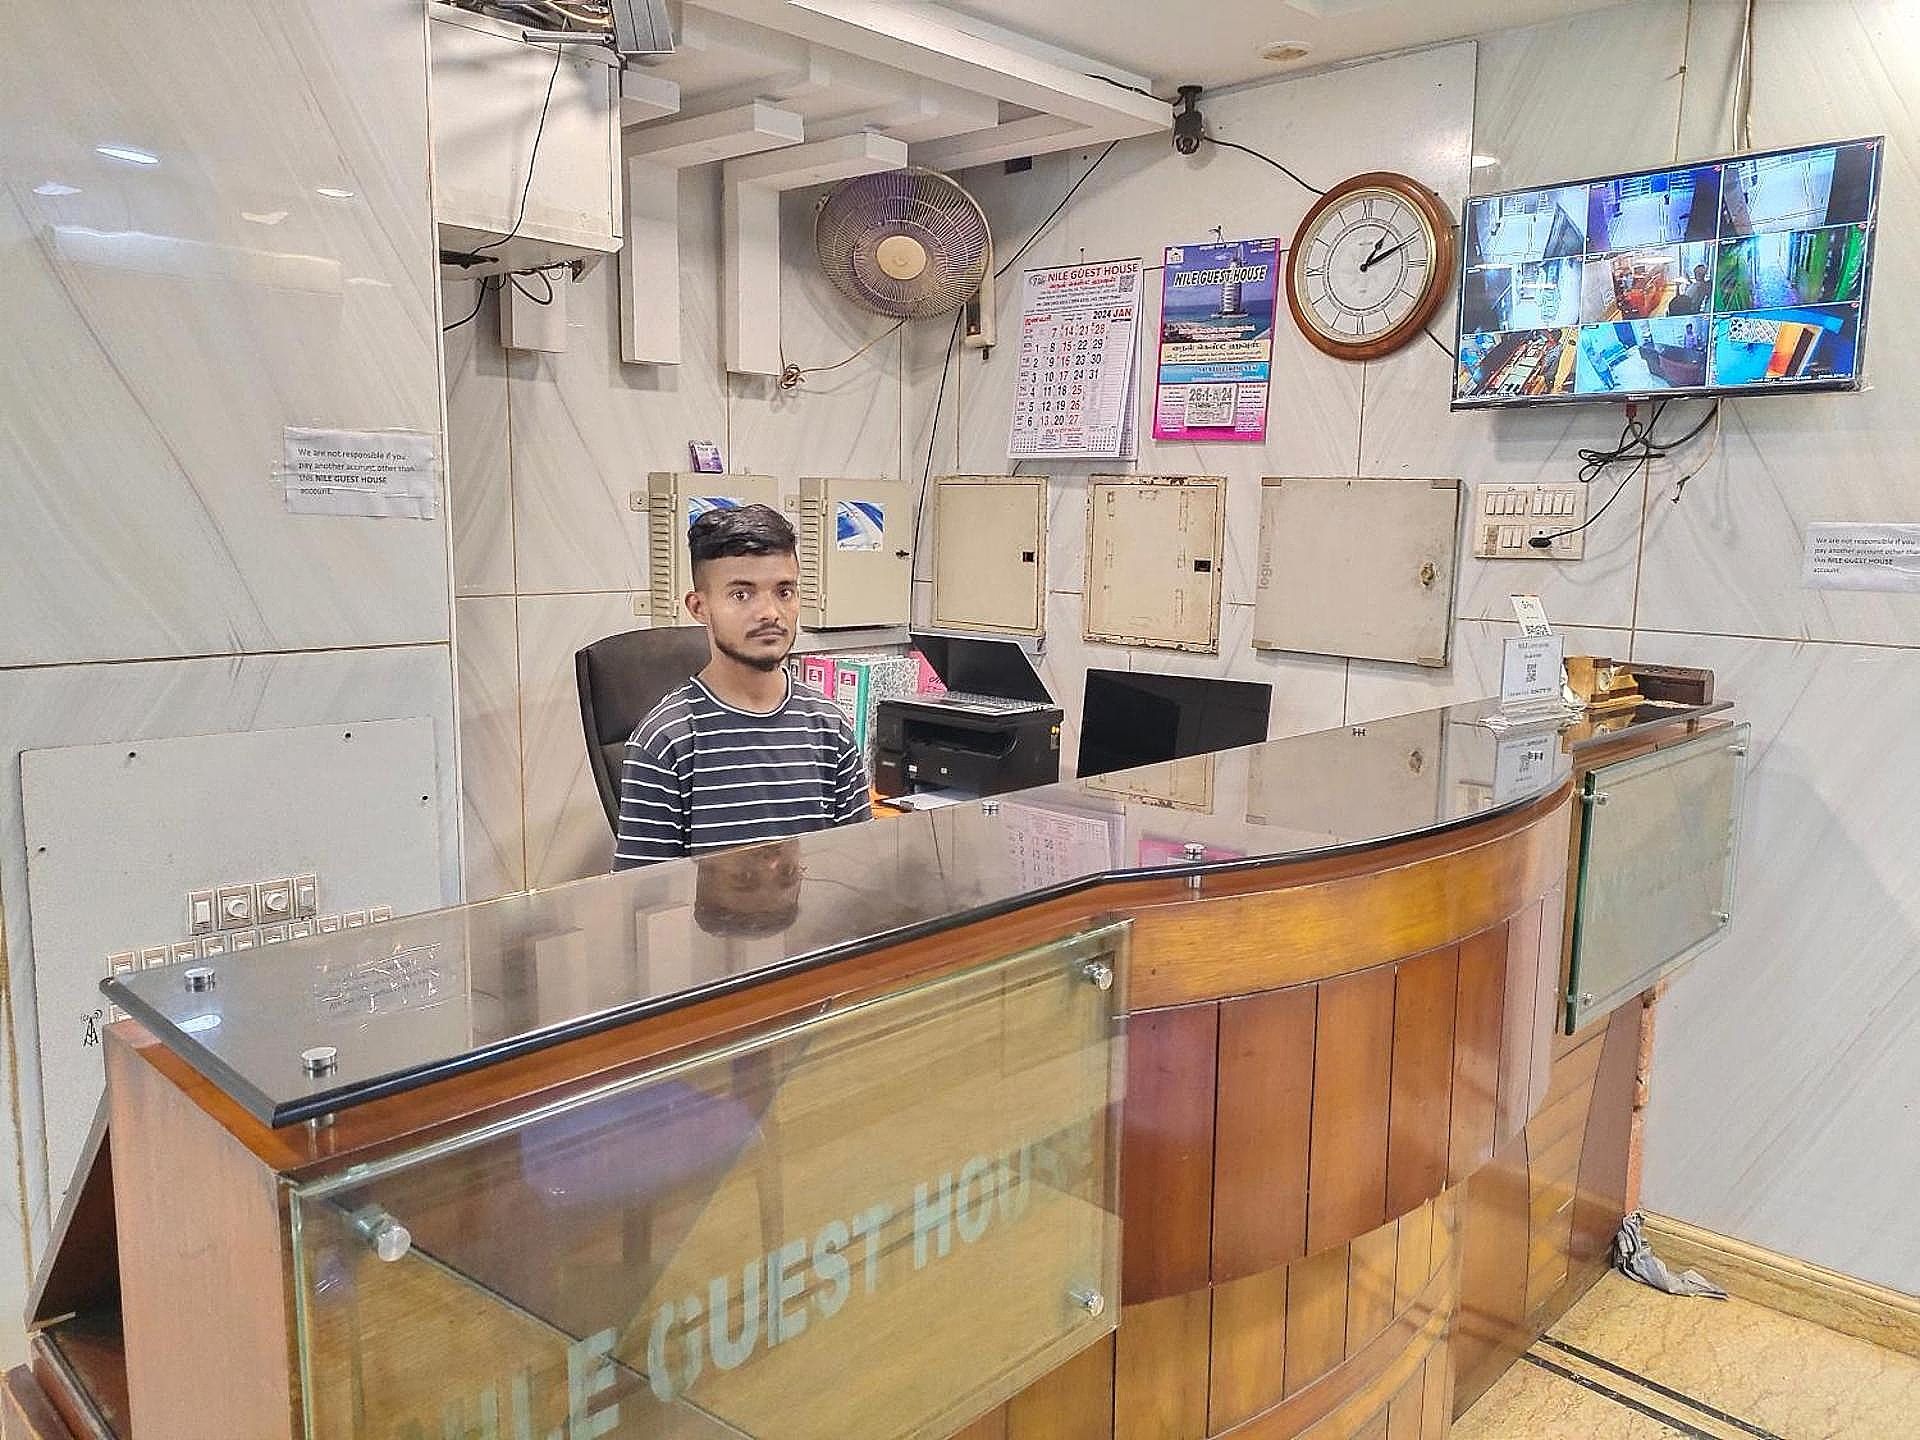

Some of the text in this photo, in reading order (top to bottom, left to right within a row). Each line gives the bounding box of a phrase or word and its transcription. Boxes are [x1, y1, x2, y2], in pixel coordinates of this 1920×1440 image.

[1048, 270, 1069, 281] NILE
[1070, 267, 1101, 280] GUEST
[1104, 263, 1139, 276] HOUSE
[1174, 265, 1268, 288] NILE GUEST HOUSE
[1093, 308, 1132, 320] 2024 JAN
[1064, 326, 1074, 336] 14
[1079, 325, 1089, 336] 21
[1094, 323, 1105, 335] 28
[1062, 341, 1072, 352] 15
[1077, 339, 1088, 350] 22
[1092, 338, 1103, 349] 29
[1061, 356, 1071, 367] 16
[1075, 354, 1086, 366] 23
[1090, 353, 1102, 364] 30
[1044, 371, 1054, 382] 10
[1060, 370, 1069, 381] 17
[1073, 369, 1084, 381] 24
[1088, 369, 1099, 380] 31
[1044, 386, 1052, 397] 11
[1058, 385, 1067, 396] 18
[1071, 384, 1082, 395] 25
[1042, 400, 1052, 412] 12
[1056, 400, 1066, 411] 19
[1070, 399, 1081, 410] 26
[1041, 415, 1049, 426] 13
[1054, 415, 1065, 426] 20
[1069, 414, 1080, 425] 27
[298, 448, 311, 457] We
[327, 450, 341, 458] not
[377, 464, 396, 472] other
[315, 474, 332, 482] NILE
[334, 475, 359, 483] GUEST
[361, 475, 387, 484] HOUSE
[1868, 558, 1893, 566] HOUSE
[648, 1200, 892, 1404] GUEST
[913, 1118, 1096, 1270] HOU
